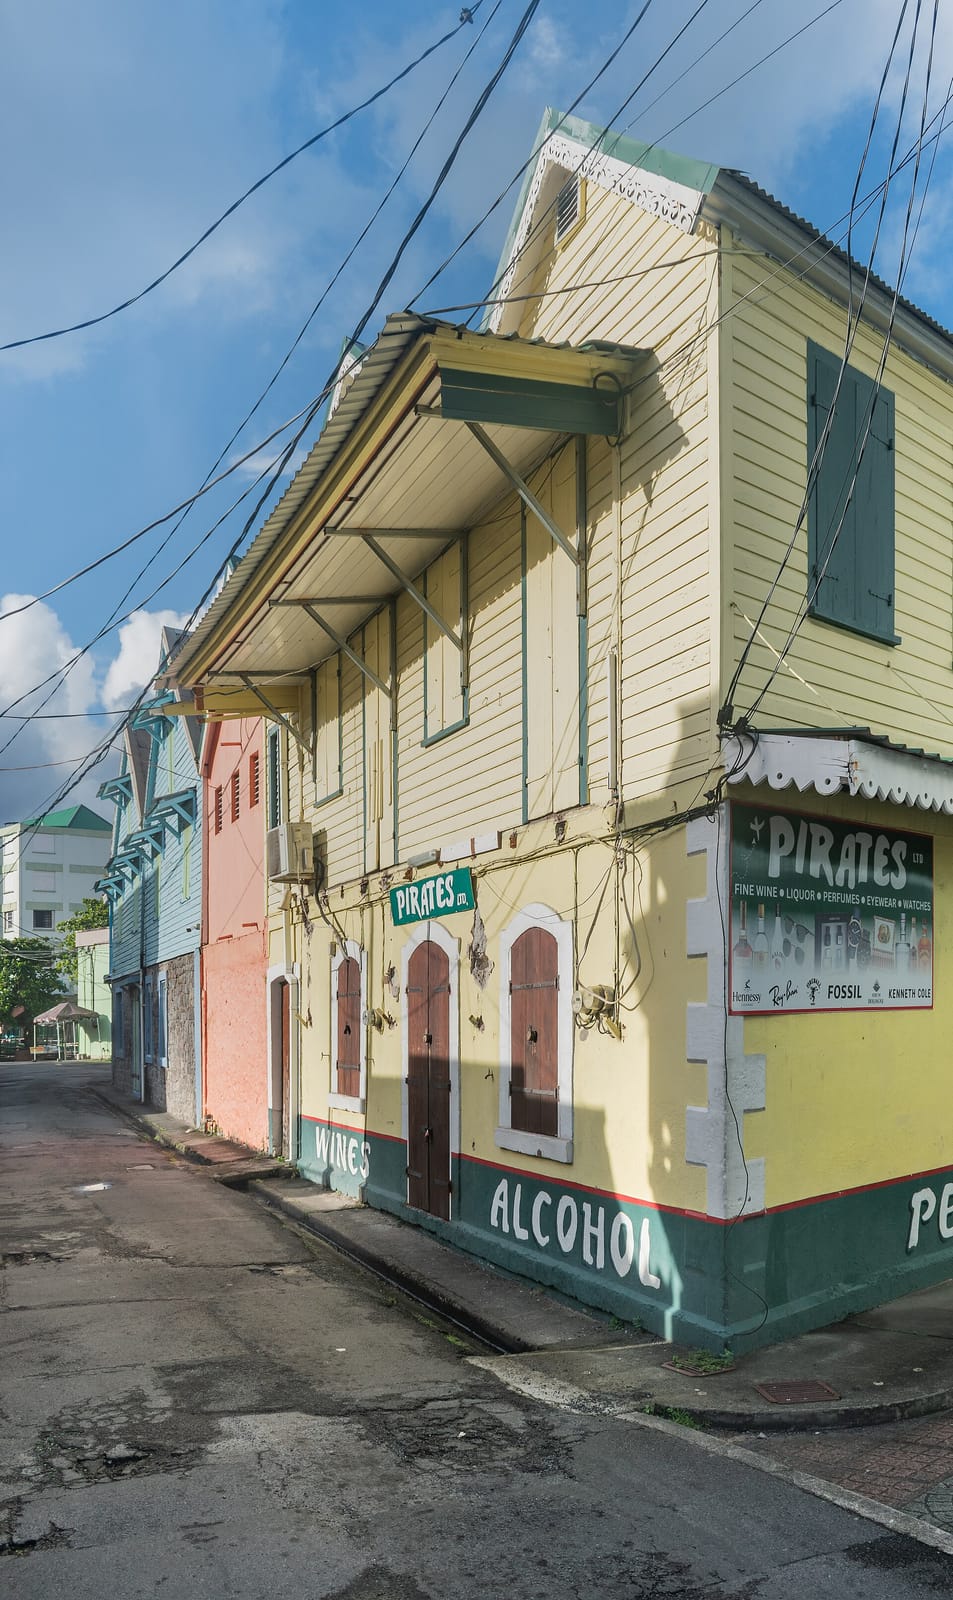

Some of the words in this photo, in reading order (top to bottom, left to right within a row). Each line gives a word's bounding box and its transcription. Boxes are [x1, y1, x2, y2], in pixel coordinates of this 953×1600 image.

[768, 815, 907, 890] PIRATES
[396, 875, 454, 919] PIRATES
[734, 883, 754, 896] FINE
[756, 885, 778, 898] WINE
[786, 887, 815, 902] LIQUOR
[823, 891, 860, 905] PERFUMES
[866, 895, 897, 908] EYEWEAR
[902, 899, 931, 911] WATCHES
[732, 991, 761, 1003] Hennessy
[828, 984, 862, 999] FOSSIL
[888, 988, 916, 999] KENNETH
[917, 988, 931, 998] COLE
[315, 1126, 371, 1179] WINES
[490, 1178, 661, 1289] ALCOHOL
